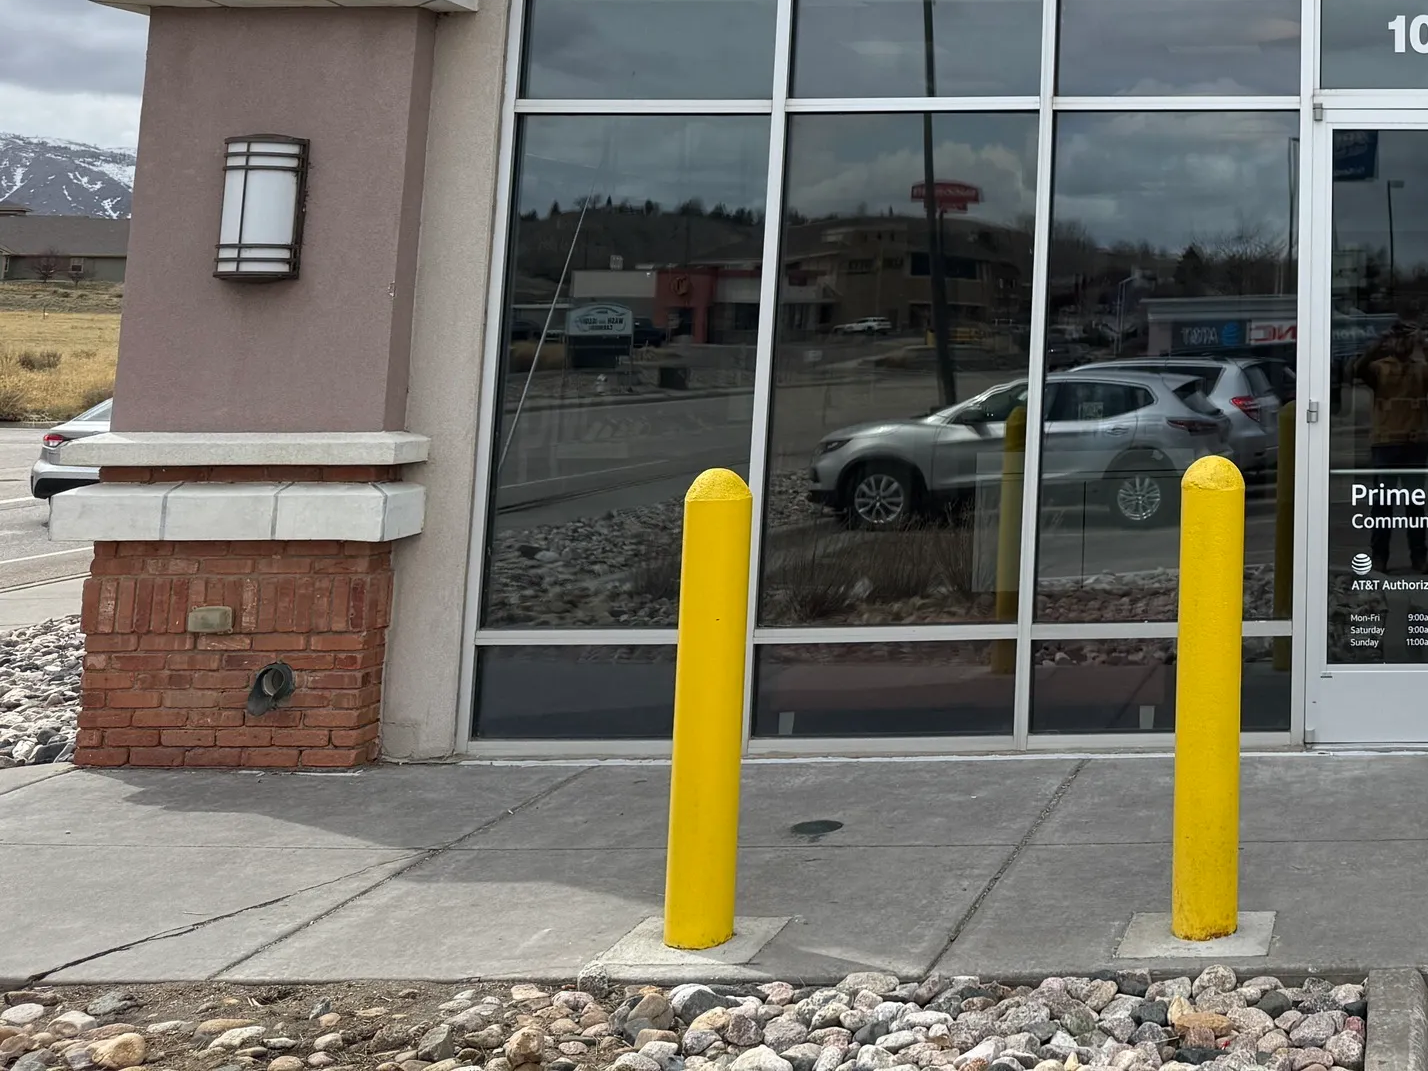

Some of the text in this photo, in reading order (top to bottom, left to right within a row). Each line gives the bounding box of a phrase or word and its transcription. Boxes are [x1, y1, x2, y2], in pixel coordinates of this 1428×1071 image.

[1351, 483, 1426, 506] Prime
[1351, 580, 1380, 591] AT&T
[1350, 613, 1381, 622] Mon-Fri
[1350, 626, 1385, 636] Saturday
[1350, 638, 1380, 648] Sunday
